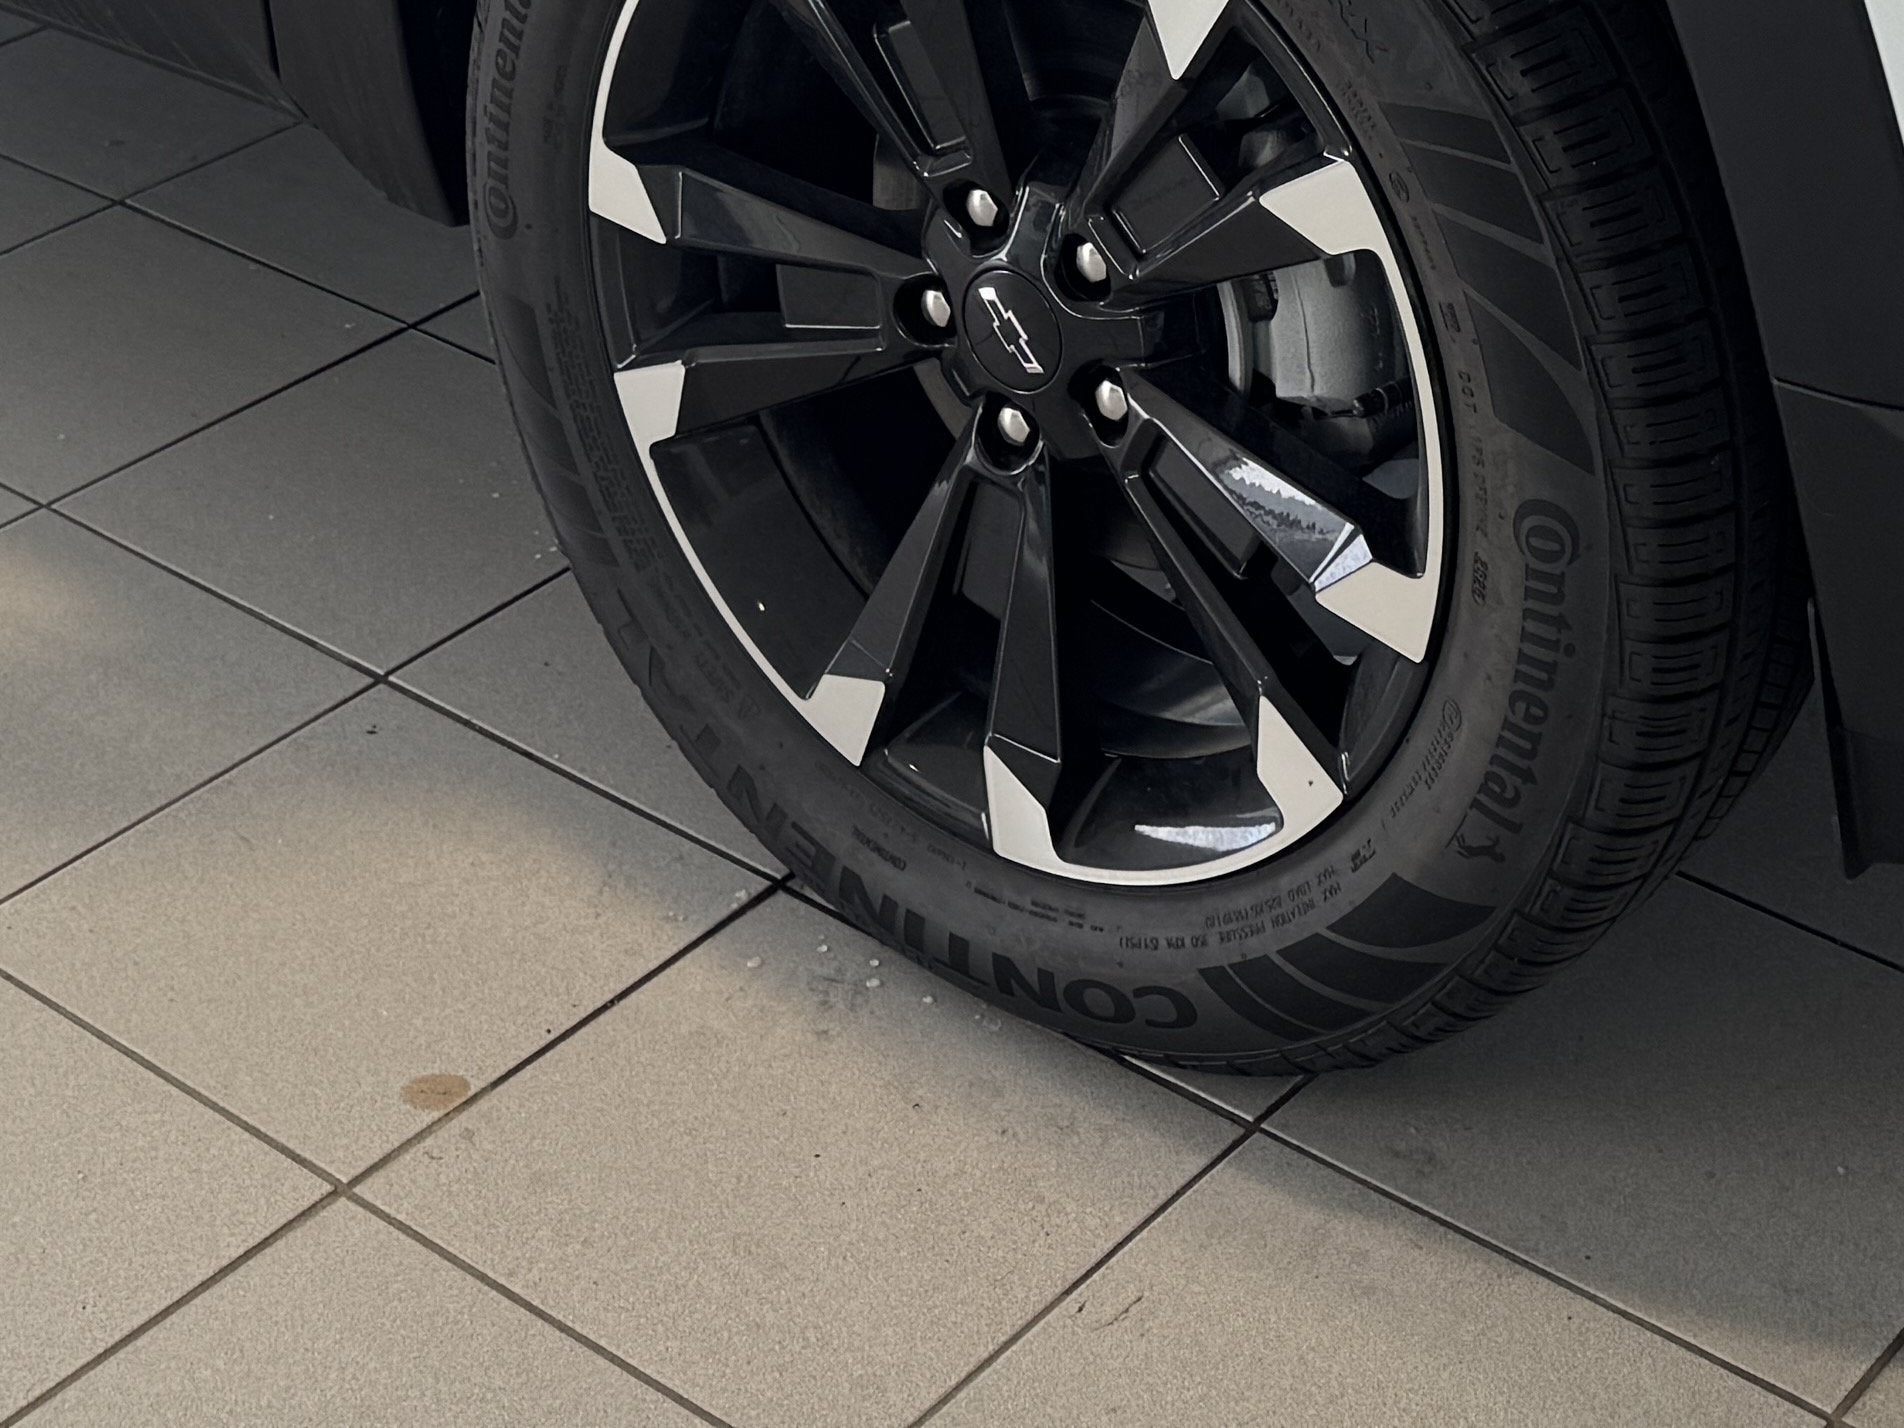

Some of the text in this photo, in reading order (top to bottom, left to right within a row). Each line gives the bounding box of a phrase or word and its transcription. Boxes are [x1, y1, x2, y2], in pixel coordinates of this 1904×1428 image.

[1457, 369, 1479, 416] DOT
[1469, 497, 1580, 836] Continental
[1218, 920, 1267, 945] PRESSURE
